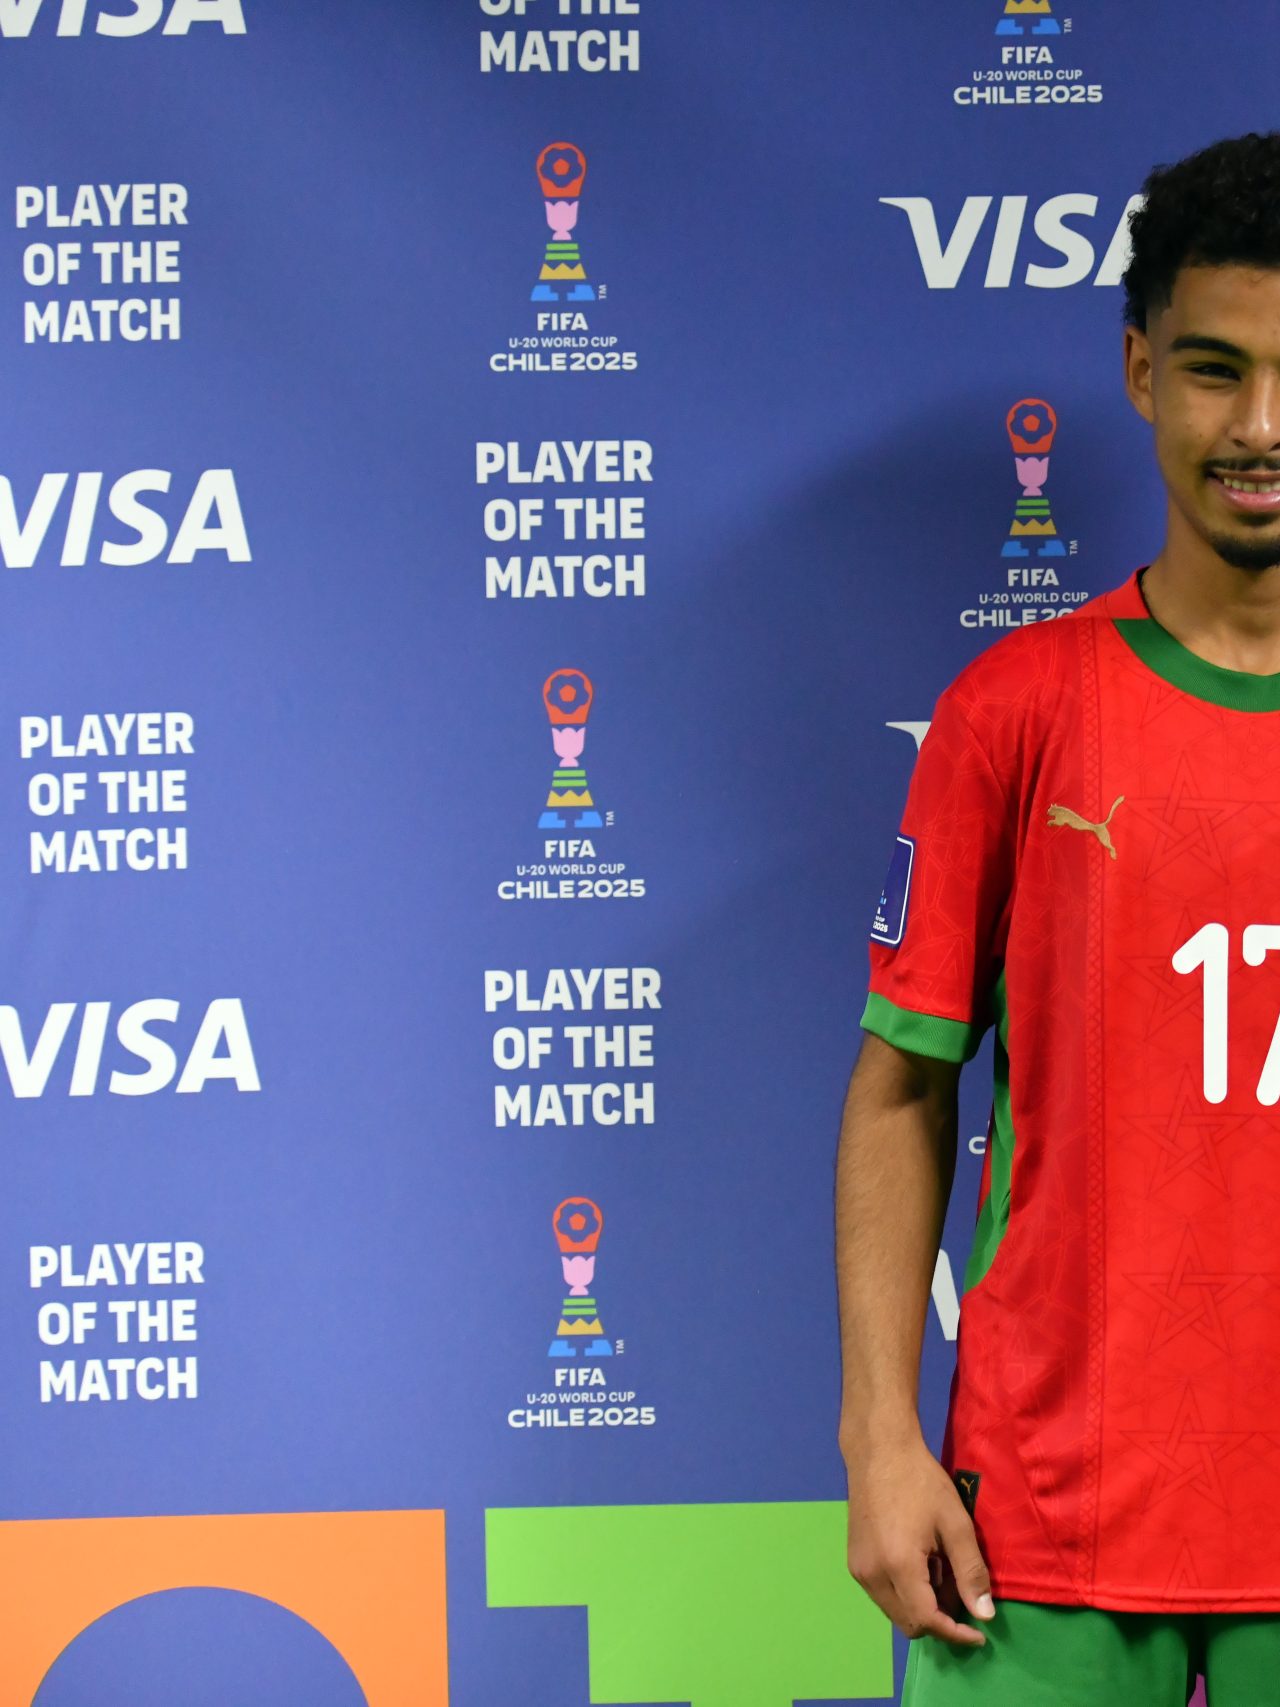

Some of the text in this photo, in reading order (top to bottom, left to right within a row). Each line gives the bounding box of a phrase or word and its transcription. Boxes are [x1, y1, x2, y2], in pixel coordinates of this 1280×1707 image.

[481, 30, 639, 72] MATCH
[1002, 47, 1053, 64] FIFA
[974, 70, 1082, 81] U-20 WORLD CUP
[16, 184, 187, 228] PLAYER
[24, 241, 179, 285] OF THE
[25, 299, 179, 343] MATCH
[509, 337, 617, 348] U-20 WORLD CUP
[538, 313, 588, 330] FIFA
[476, 441, 652, 483] PLAYER
[0, 469, 251, 568] VISA
[484, 498, 644, 541] OF THE
[486, 555, 645, 598] MATCH
[980, 592, 1088, 604] U-20 WORLD CUP
[1008, 569, 1059, 586] FIFA
[960, 609, 1037, 627] CHILE
[21, 713, 193, 758] PLAYER
[29, 770, 186, 816] OF THE
[31, 828, 186, 873] MATCH
[517, 864, 625, 875] U-20 WORLD CUP
[545, 840, 595, 858] FIFA
[485, 968, 661, 1012] PLAYER
[0, 999, 260, 1098] VISA
[493, 1025, 653, 1069] OF THE
[495, 1083, 654, 1127] MATCH
[30, 1242, 204, 1287] PLAYER
[38, 1300, 196, 1345] OF THE
[40, 1357, 197, 1402] MATCH
[527, 1392, 635, 1404] U-20 WORLD CUP
[555, 1368, 605, 1386] FIFA
